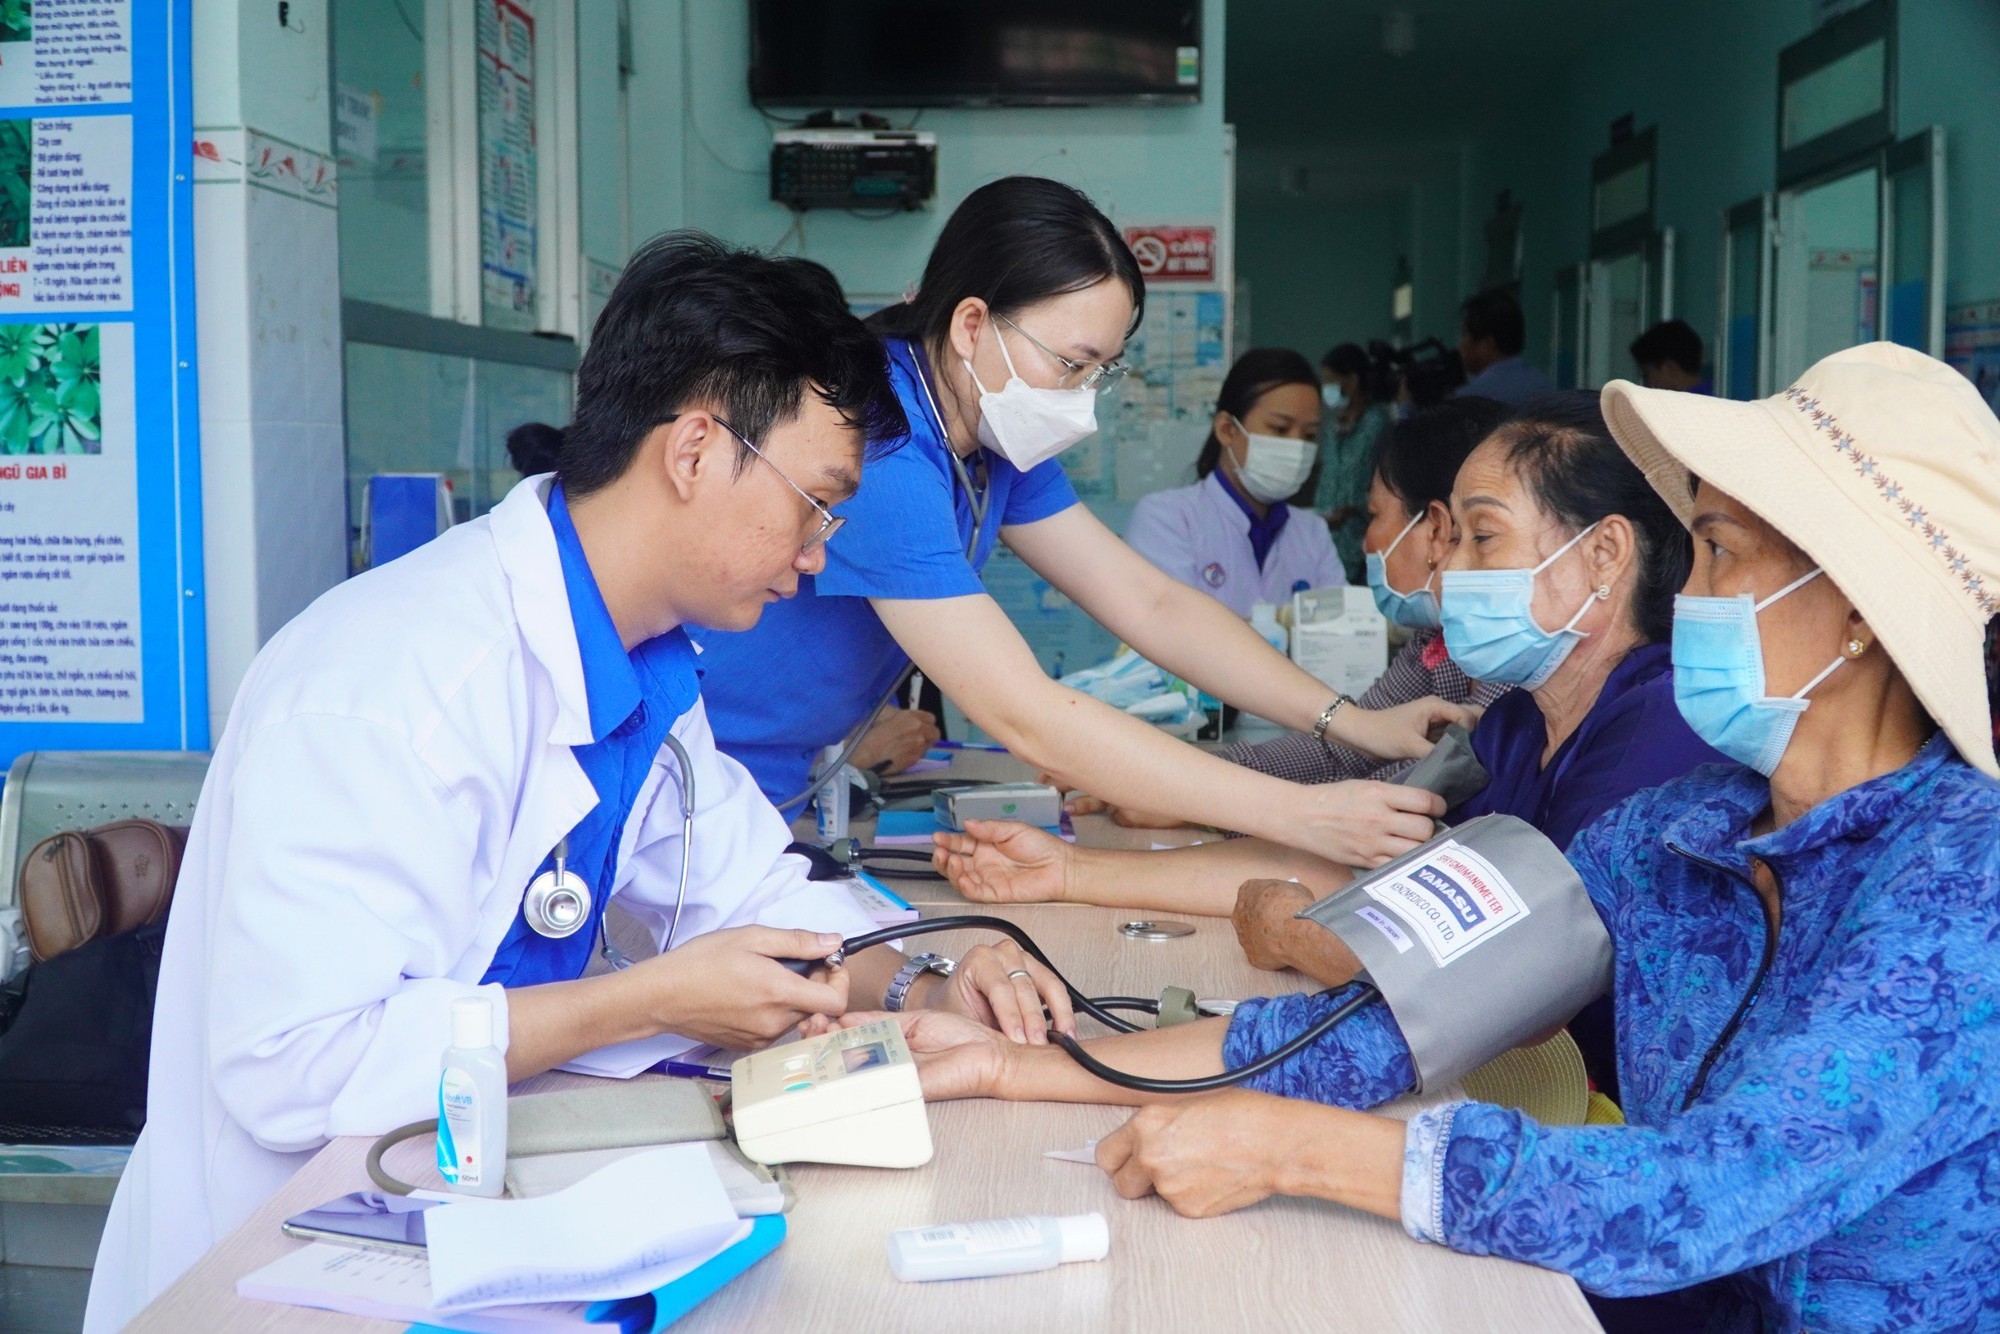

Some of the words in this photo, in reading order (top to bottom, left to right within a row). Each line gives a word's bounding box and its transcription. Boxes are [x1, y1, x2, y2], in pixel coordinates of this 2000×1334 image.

[26, 466, 48, 480] GIA
[52, 464, 66, 480] BÌ
[1418, 868, 1479, 923] YAMASU
[1384, 925, 1400, 941] Japan
[1436, 920, 1457, 944] LTD.
[461, 1174, 479, 1182] 60ml
